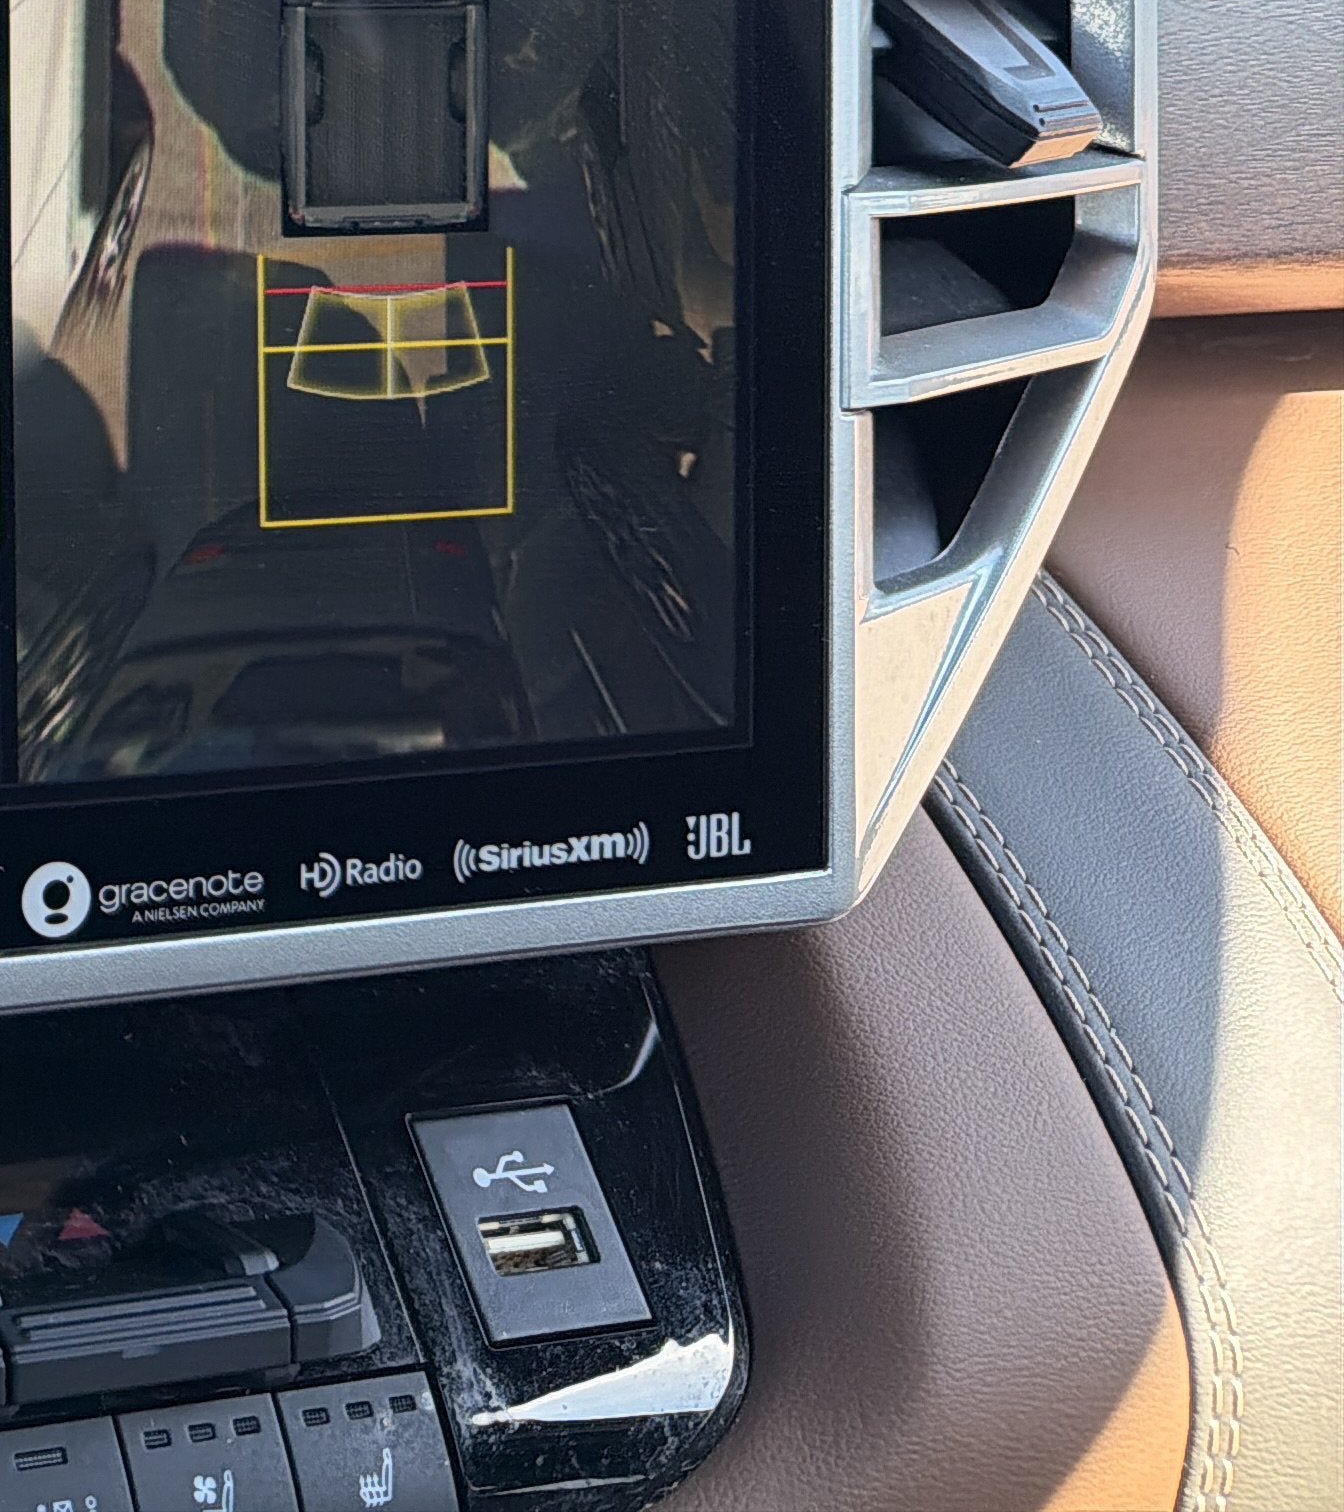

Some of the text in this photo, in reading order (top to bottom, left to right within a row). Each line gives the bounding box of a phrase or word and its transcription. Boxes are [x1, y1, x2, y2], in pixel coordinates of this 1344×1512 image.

[685, 811, 752, 860] JBL
[346, 852, 422, 885] Radio
[98, 869, 264, 913] gracenote
[131, 898, 266, 923] A NIELSEN COMPANY
